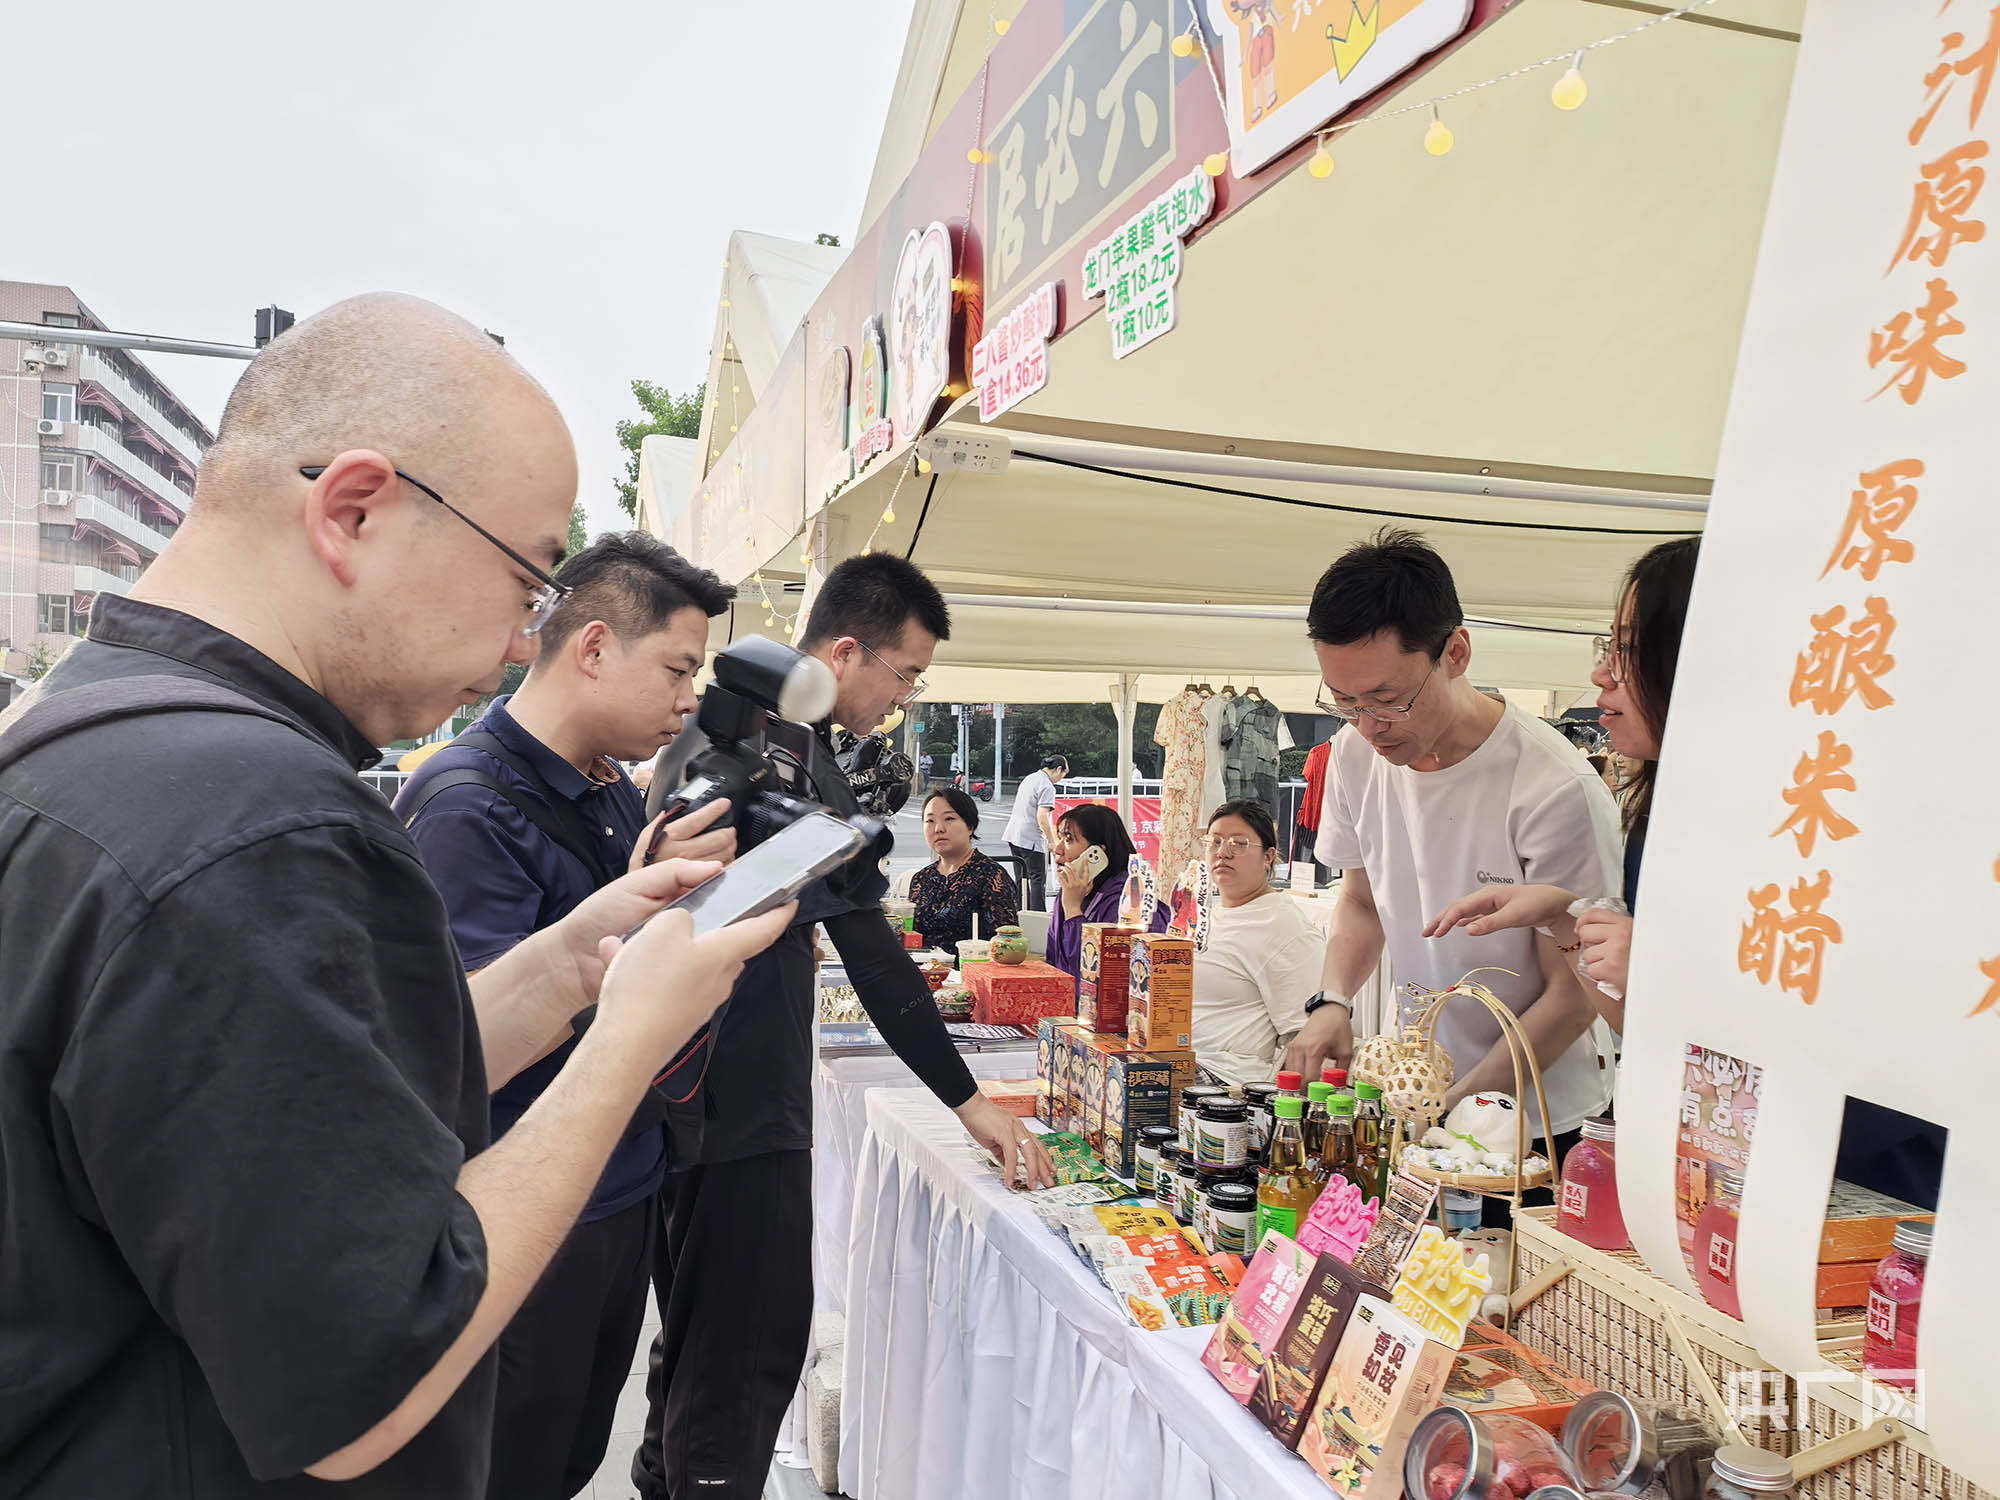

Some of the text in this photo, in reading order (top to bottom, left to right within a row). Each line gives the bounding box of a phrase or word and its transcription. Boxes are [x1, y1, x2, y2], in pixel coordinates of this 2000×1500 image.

[1085, 175, 1204, 292] 龙门苹果醋气泡水
[1863, 0, 2000, 405] 汁原味
[1108, 242, 1175, 313] 2瓶18.2元
[1115, 290, 1169, 348] 1瓶10元
[1737, 458, 1926, 1006] 原酿米醋
